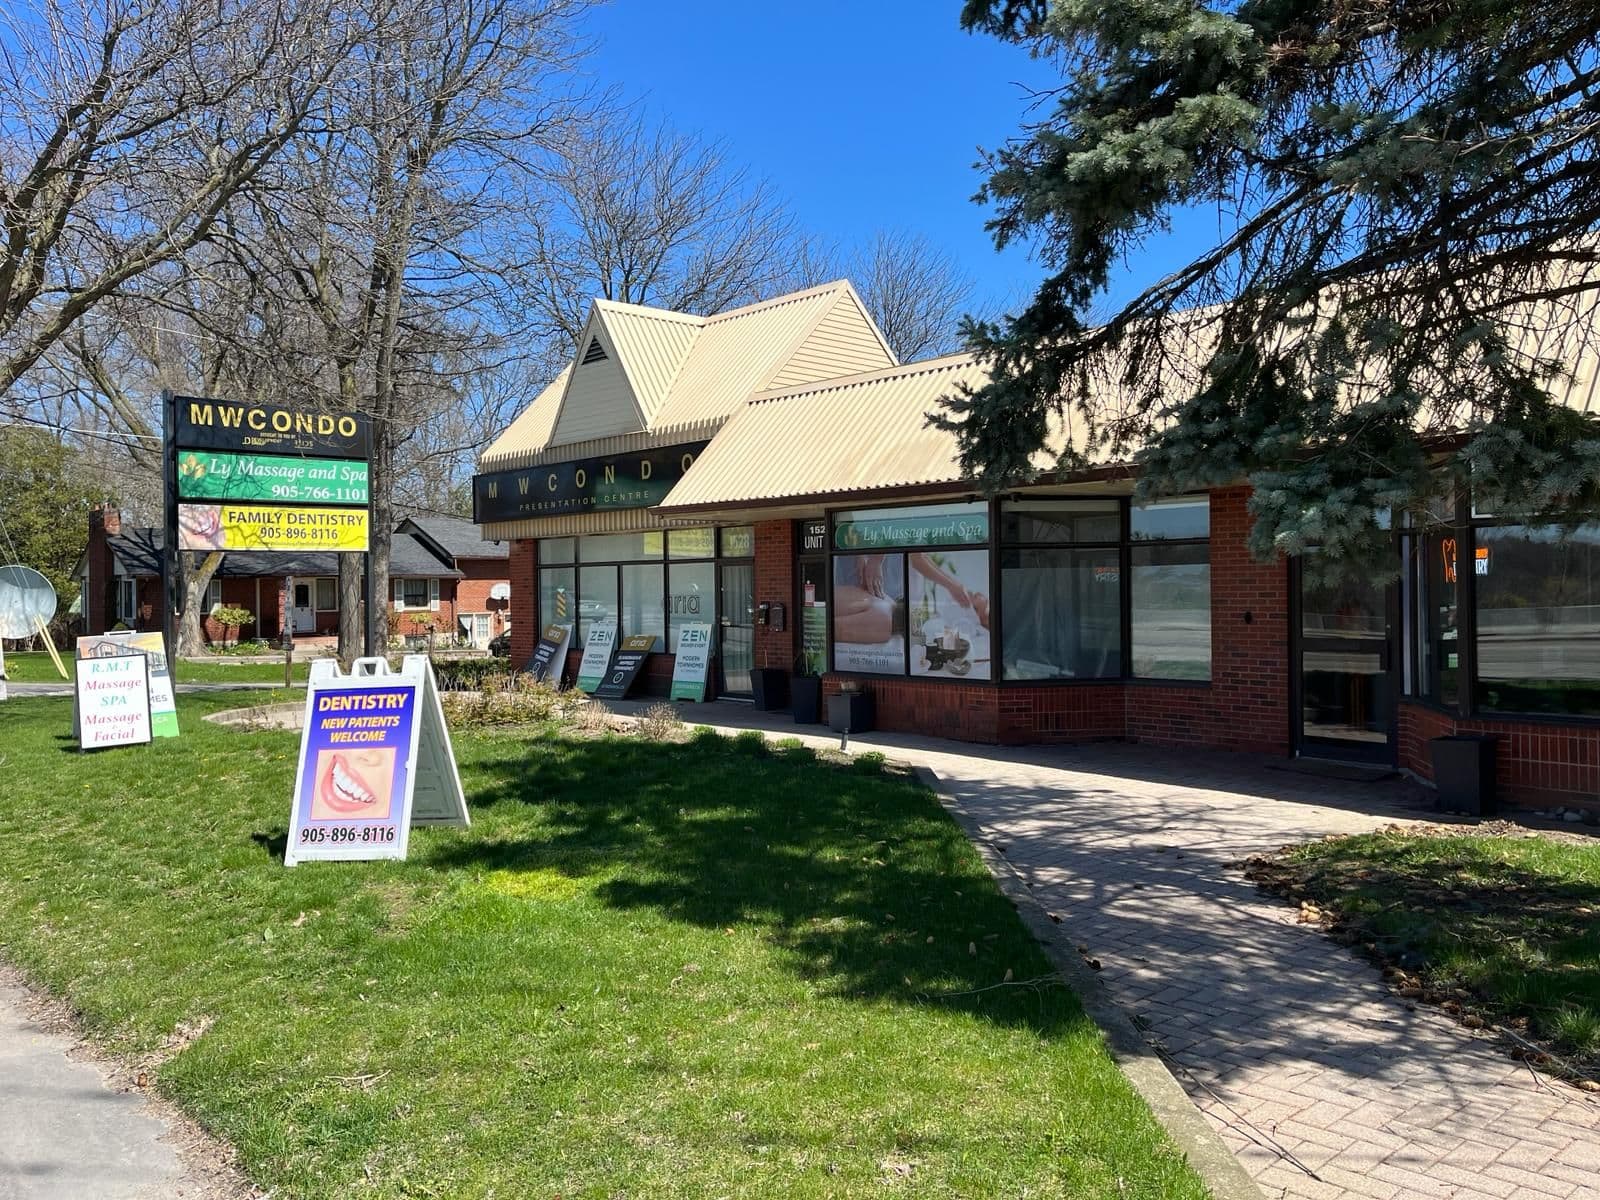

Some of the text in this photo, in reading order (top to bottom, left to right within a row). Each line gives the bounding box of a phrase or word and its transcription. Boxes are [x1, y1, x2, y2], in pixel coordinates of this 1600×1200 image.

[190, 403, 357, 437] MWCONDO
[209, 458, 367, 485] Ly Massage and Spa
[271, 485, 367, 500] 905-766-1101
[519, 490, 649, 511] PRESENTATION CENTRE
[228, 511, 364, 526] FAMILY DENTISTRY
[260, 527, 338, 539] 905-896-8116
[863, 521, 982, 545] Ly Massage and Spa
[804, 536, 824, 549] UNIT
[590, 631, 613, 641] ZEN
[681, 630, 708, 642] ZEN
[85, 680, 142, 691] Massage
[100, 695, 128, 706] SPA
[319, 694, 408, 711] DENTISTRY
[85, 713, 142, 725] Massage
[321, 716, 400, 729] NEW PATIENTS
[94, 728, 136, 742] Facial
[330, 731, 386, 743] WELCOME
[301, 827, 394, 843] 905-896-8116
